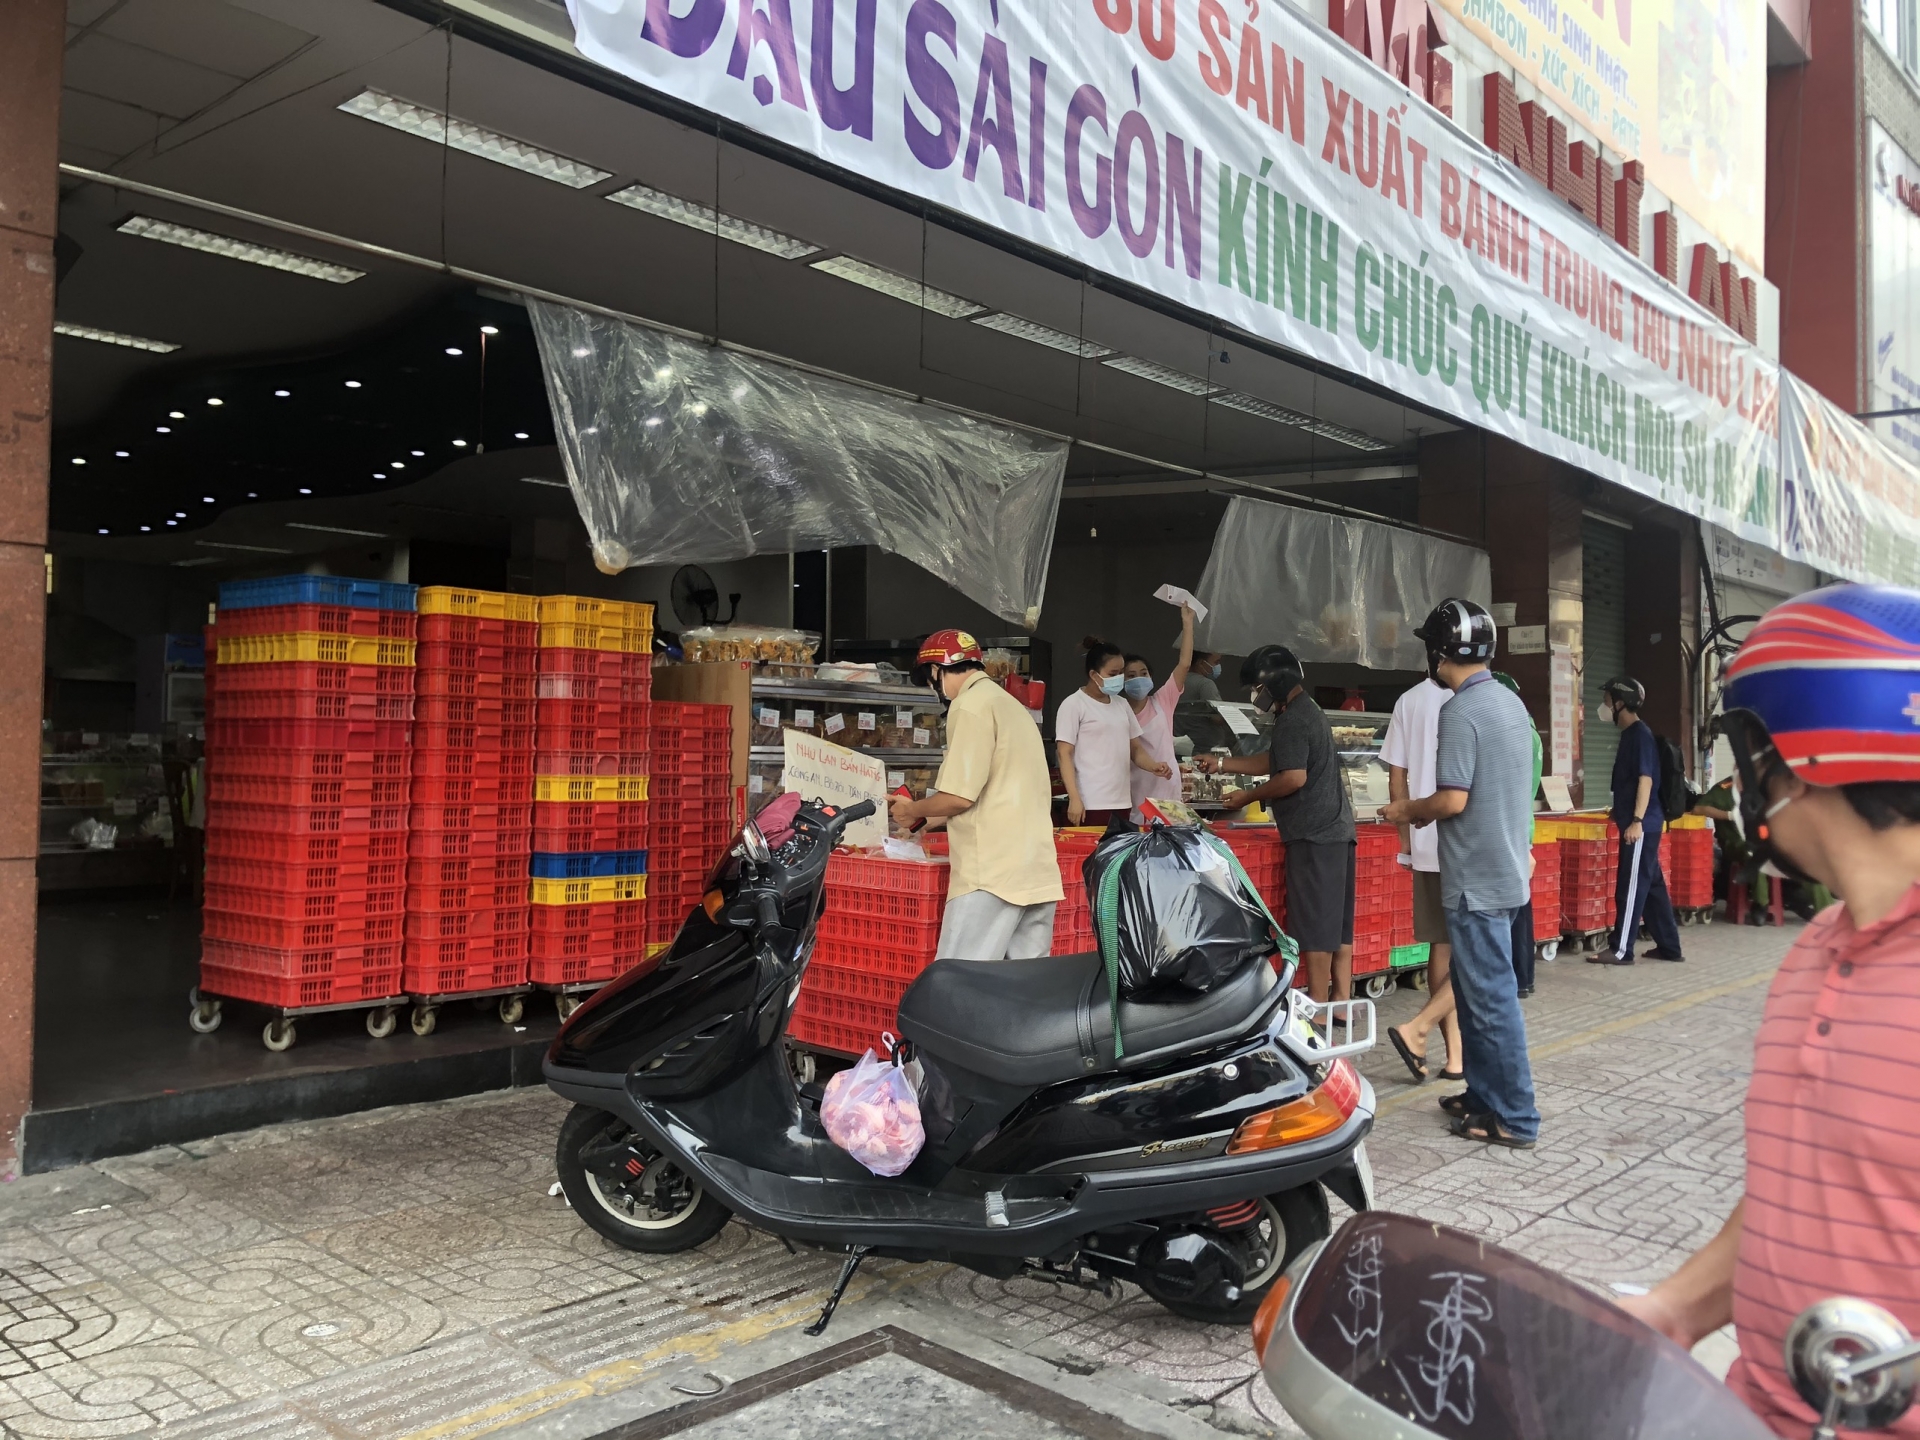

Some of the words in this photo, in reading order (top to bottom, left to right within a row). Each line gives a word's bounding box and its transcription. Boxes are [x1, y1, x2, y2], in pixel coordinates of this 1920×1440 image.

[1562, 12, 1592, 66] SINH
[1541, 43, 1567, 93] XÚC
[1572, 70, 1602, 122] XÍCH
[1198, 0, 1305, 147] SẢN
[1321, 76, 1428, 220] XUẤT
[1439, 158, 1530, 284] BÁNH
[1539, 227, 1623, 344] TRUNG
[1630, 291, 1671, 371] THU
[1064, 64, 1202, 281] GÒN
[1218, 156, 1340, 335] KÍNH
[1353, 250, 1459, 388] CHÚC
[1470, 303, 1531, 422] QUÝ
[1540, 341, 1628, 465] KHÁCH
[1634, 392, 1676, 500] MỌI
[818, 748, 837, 766] LAN
